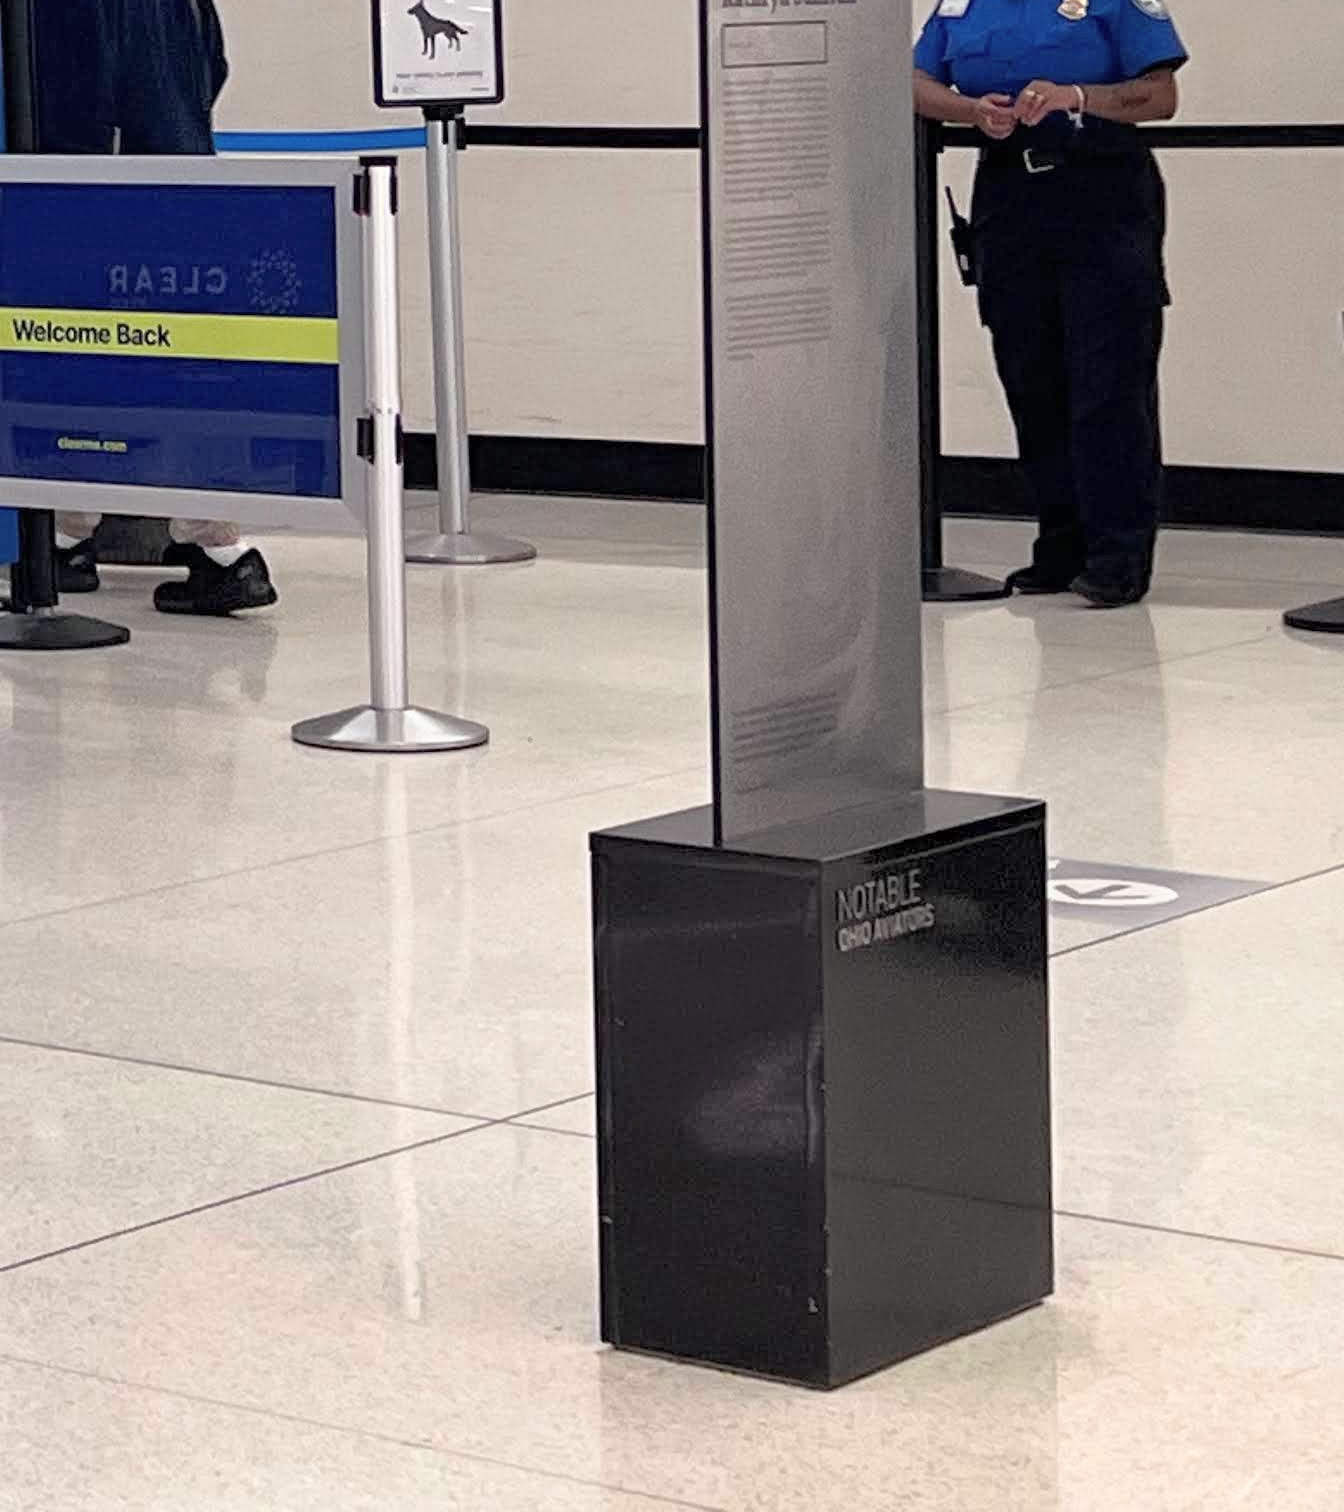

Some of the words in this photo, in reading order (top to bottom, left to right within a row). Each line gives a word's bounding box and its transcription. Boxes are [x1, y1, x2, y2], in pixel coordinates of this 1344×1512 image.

[13, 318, 111, 345] Welcome
[116, 322, 171, 347] Back
[836, 869, 921, 922] NOTABLE
